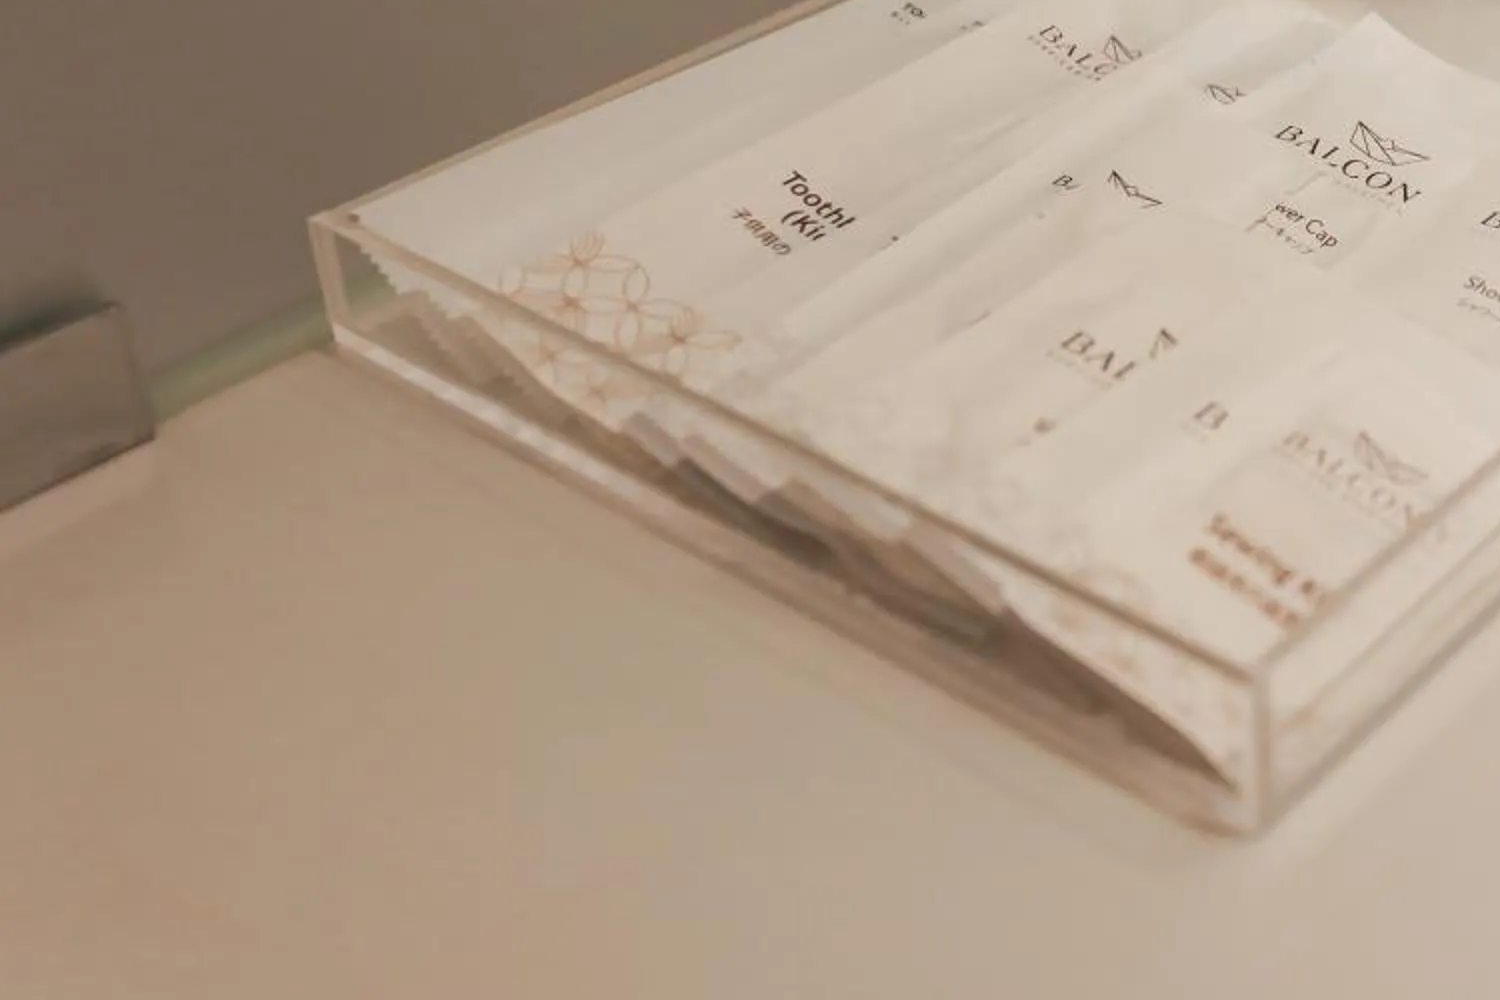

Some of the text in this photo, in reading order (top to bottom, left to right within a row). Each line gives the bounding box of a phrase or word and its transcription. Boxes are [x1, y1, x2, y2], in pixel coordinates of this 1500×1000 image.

[1040, 24, 1115, 75] BALC
[1275, 125, 1421, 203] BALCON
[1275, 204, 1304, 223] wer
[1305, 219, 1337, 248] Cap
[1283, 430, 1428, 530] BALCON
